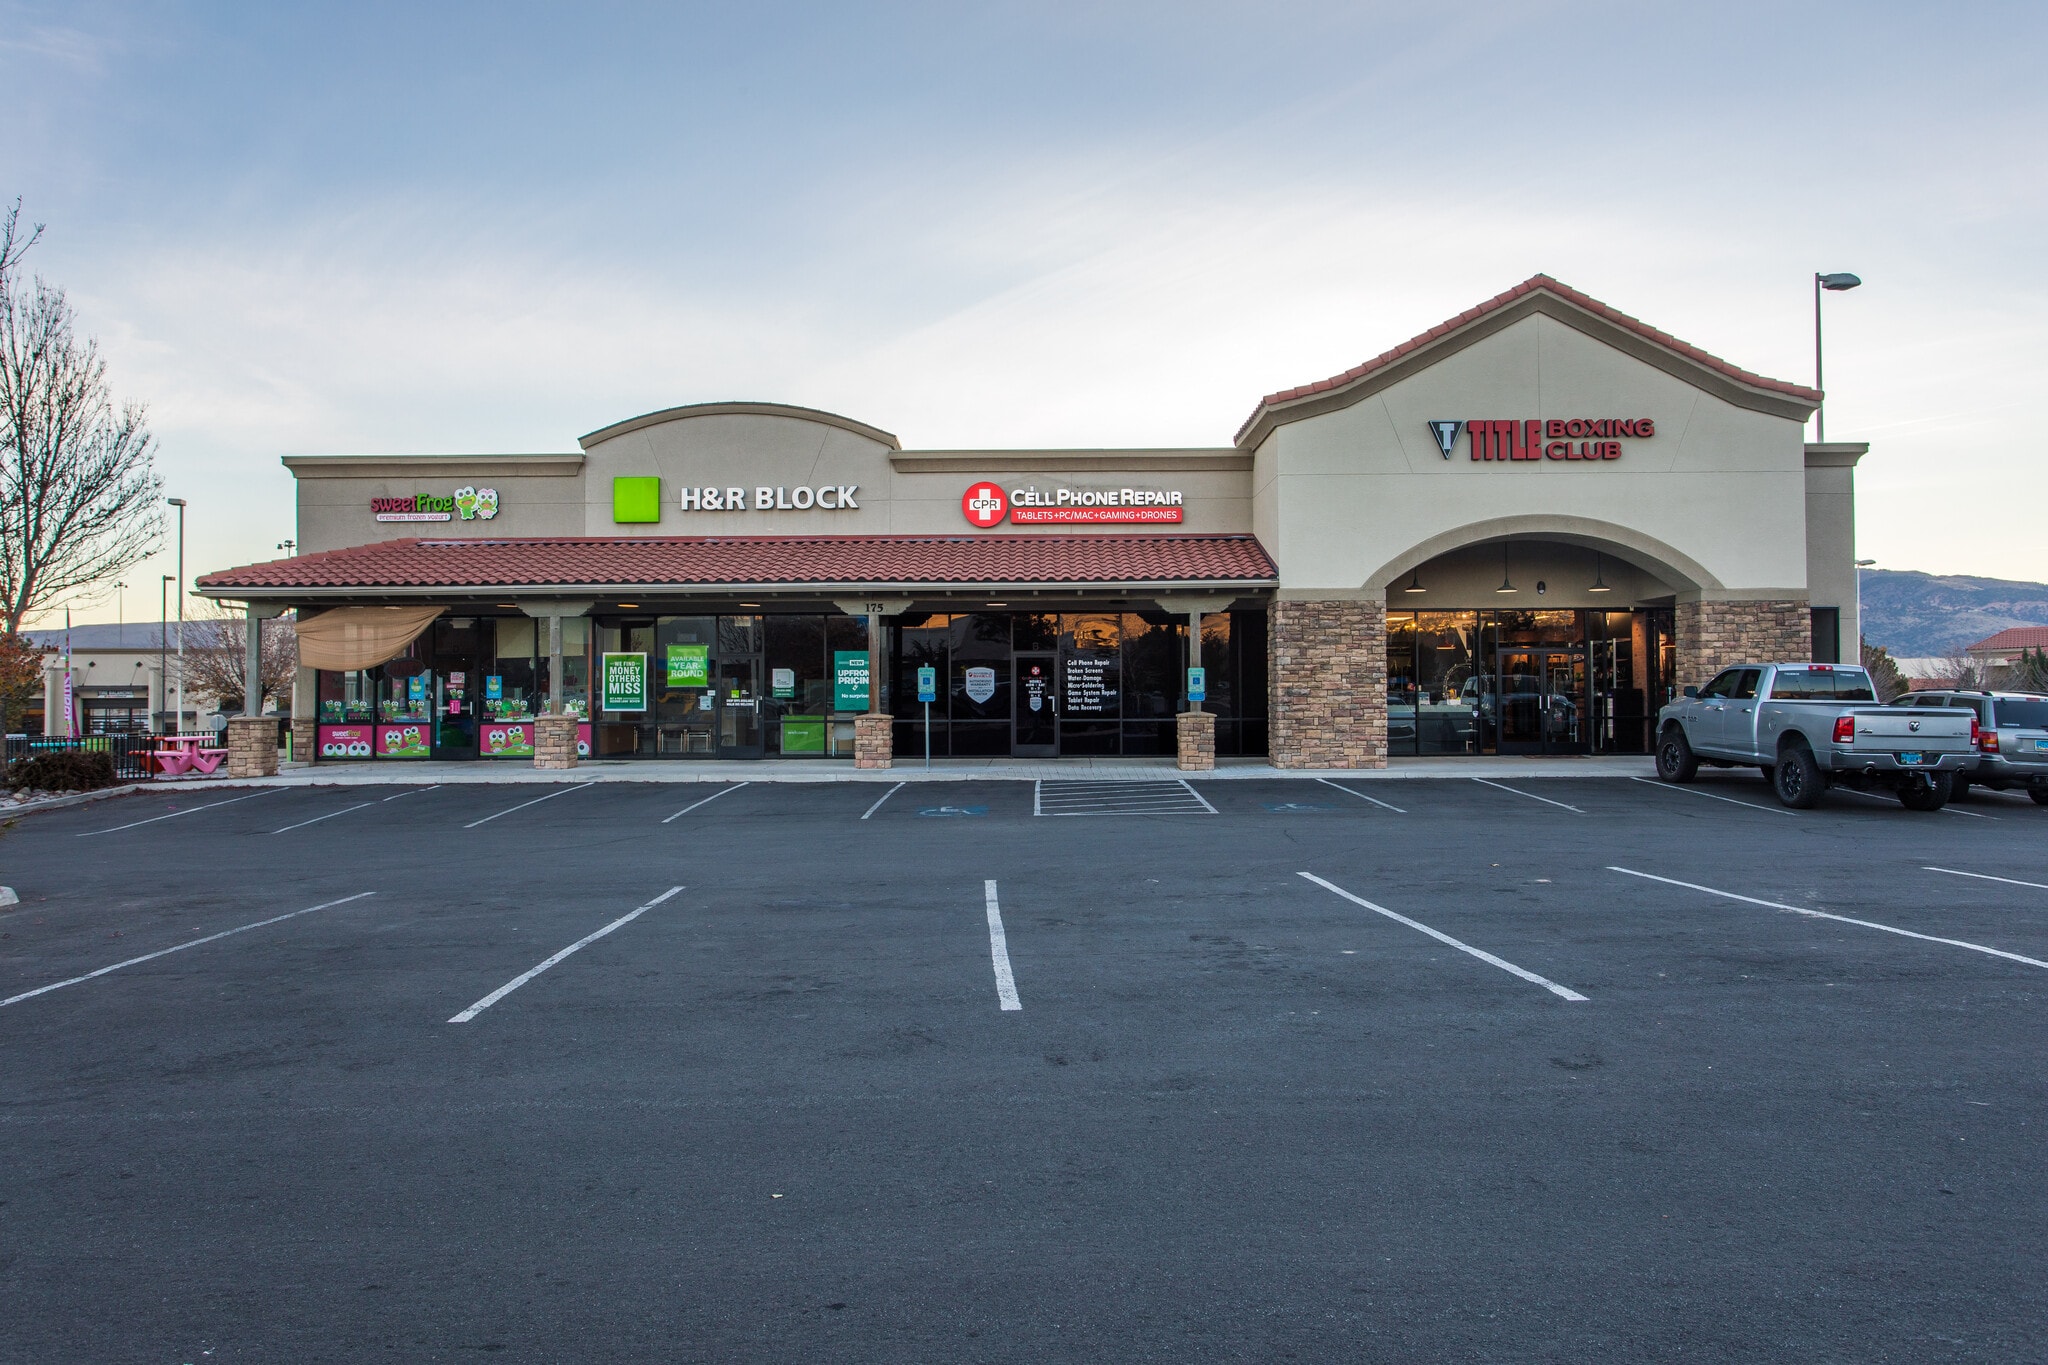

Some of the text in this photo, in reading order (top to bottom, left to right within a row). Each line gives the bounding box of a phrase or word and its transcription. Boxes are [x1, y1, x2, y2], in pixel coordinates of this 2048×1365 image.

[1546, 418, 1654, 437] BOXING
[1467, 420, 1541, 460] TITLE
[1546, 441, 1622, 460] CLUB
[370, 493, 455, 512] sweetFrog
[681, 485, 859, 511] H&R BLOCK
[972, 499, 998, 509] CPR
[865, 603, 884, 612] 175
[673, 662, 701, 670] YEAR-
[1094, 659, 1110, 667] Repair
[609, 666, 640, 675] MONEY
[671, 669, 704, 677] ROUND
[609, 674, 641, 683] OTHERS
[609, 682, 641, 694] MISS
[1101, 689, 1117, 697] Repair
